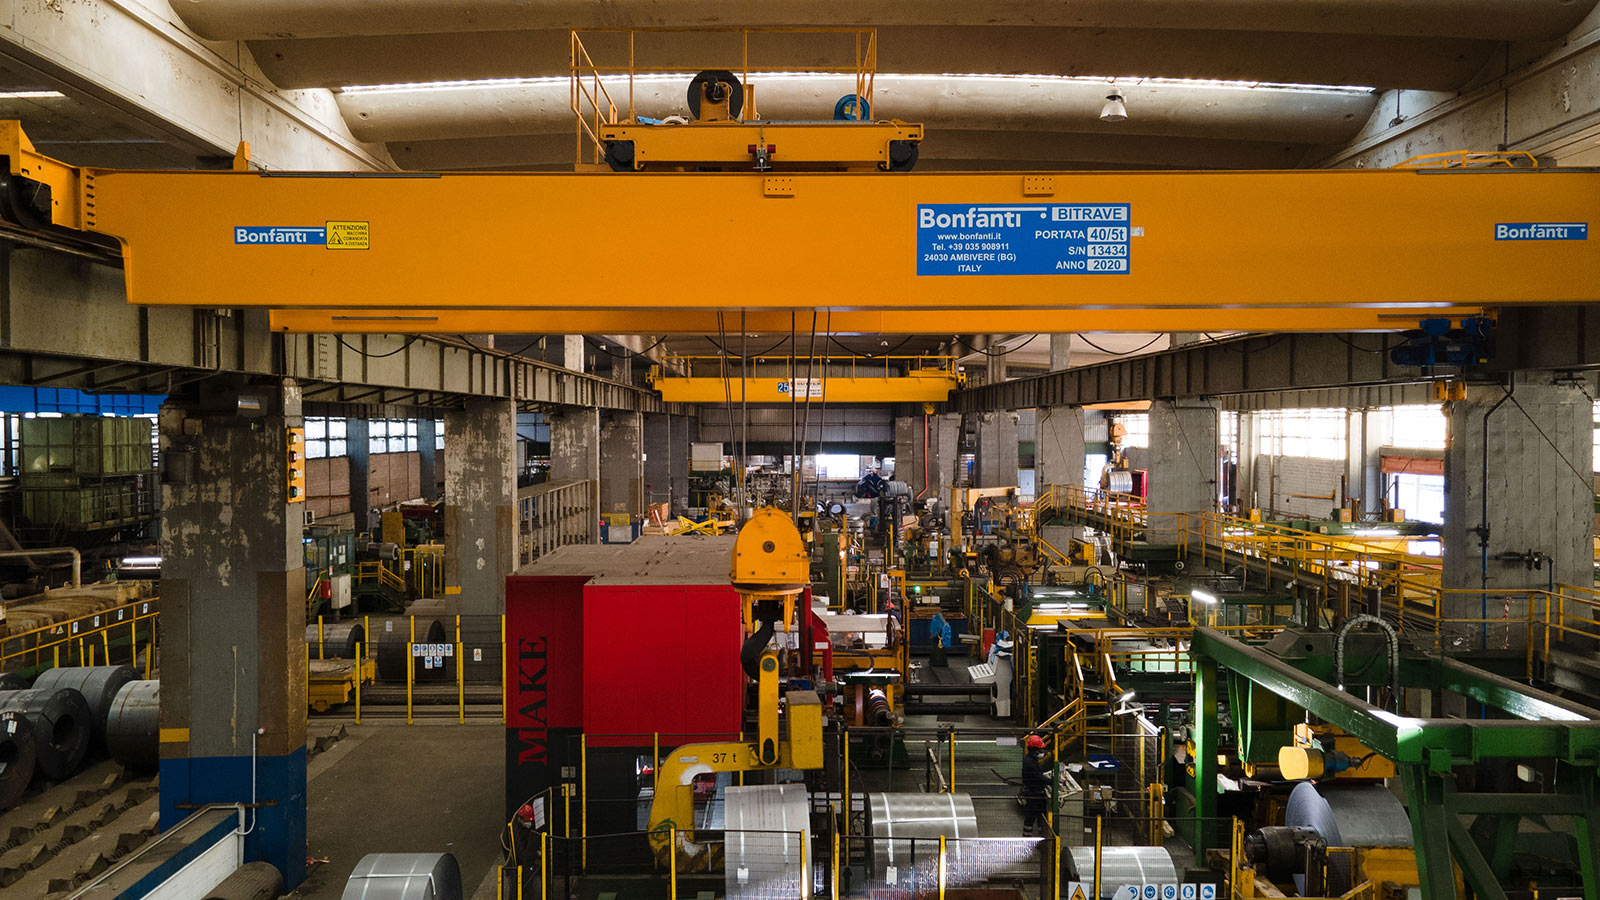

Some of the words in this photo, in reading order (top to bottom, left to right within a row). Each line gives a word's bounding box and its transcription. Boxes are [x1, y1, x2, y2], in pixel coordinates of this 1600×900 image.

[920, 207, 1021, 228] Bonfanti
[1058, 208, 1122, 220] BITRAVE
[236, 228, 307, 242] Bonfanti
[938, 232, 1002, 240] www.bonfanti.it
[1035, 230, 1086, 240] PORTATA
[1089, 228, 1125, 242] 40/5t
[1497, 224, 1568, 238] Bonfanti
[1068, 246, 1086, 256] S/N
[1091, 246, 1126, 256] 13434
[924, 254, 948, 262] 24030
[950, 254, 996, 262] AMBIVERE
[998, 253, 1016, 262] (BG)
[958, 264, 982, 272] ITALY
[1056, 261, 1086, 270] ANNO
[1093, 260, 1121, 270] 2020
[518, 636, 548, 767] MAKE
[712, 753, 726, 764] 37
[732, 753, 736, 762] t
